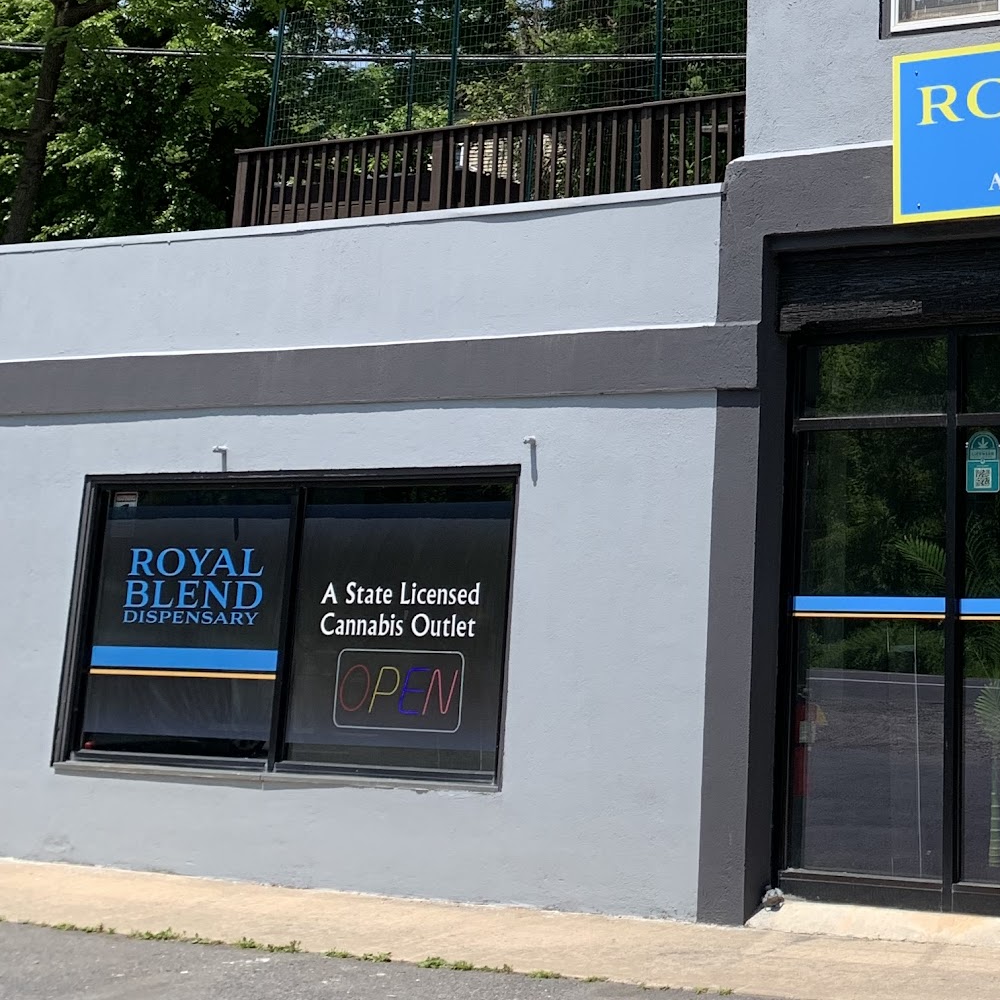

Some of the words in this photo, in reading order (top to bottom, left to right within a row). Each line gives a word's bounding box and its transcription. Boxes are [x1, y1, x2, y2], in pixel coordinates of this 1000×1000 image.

[128, 548, 264, 577] ROYAL
[123, 579, 263, 610] BLEND
[320, 581, 338, 604] A
[345, 581, 393, 605] State
[400, 581, 481, 605] Licensed
[122, 610, 259, 625] DISPENSARY
[320, 612, 404, 636] Cannabis
[411, 613, 476, 637] Outlet
[339, 664, 459, 715] OPEN
